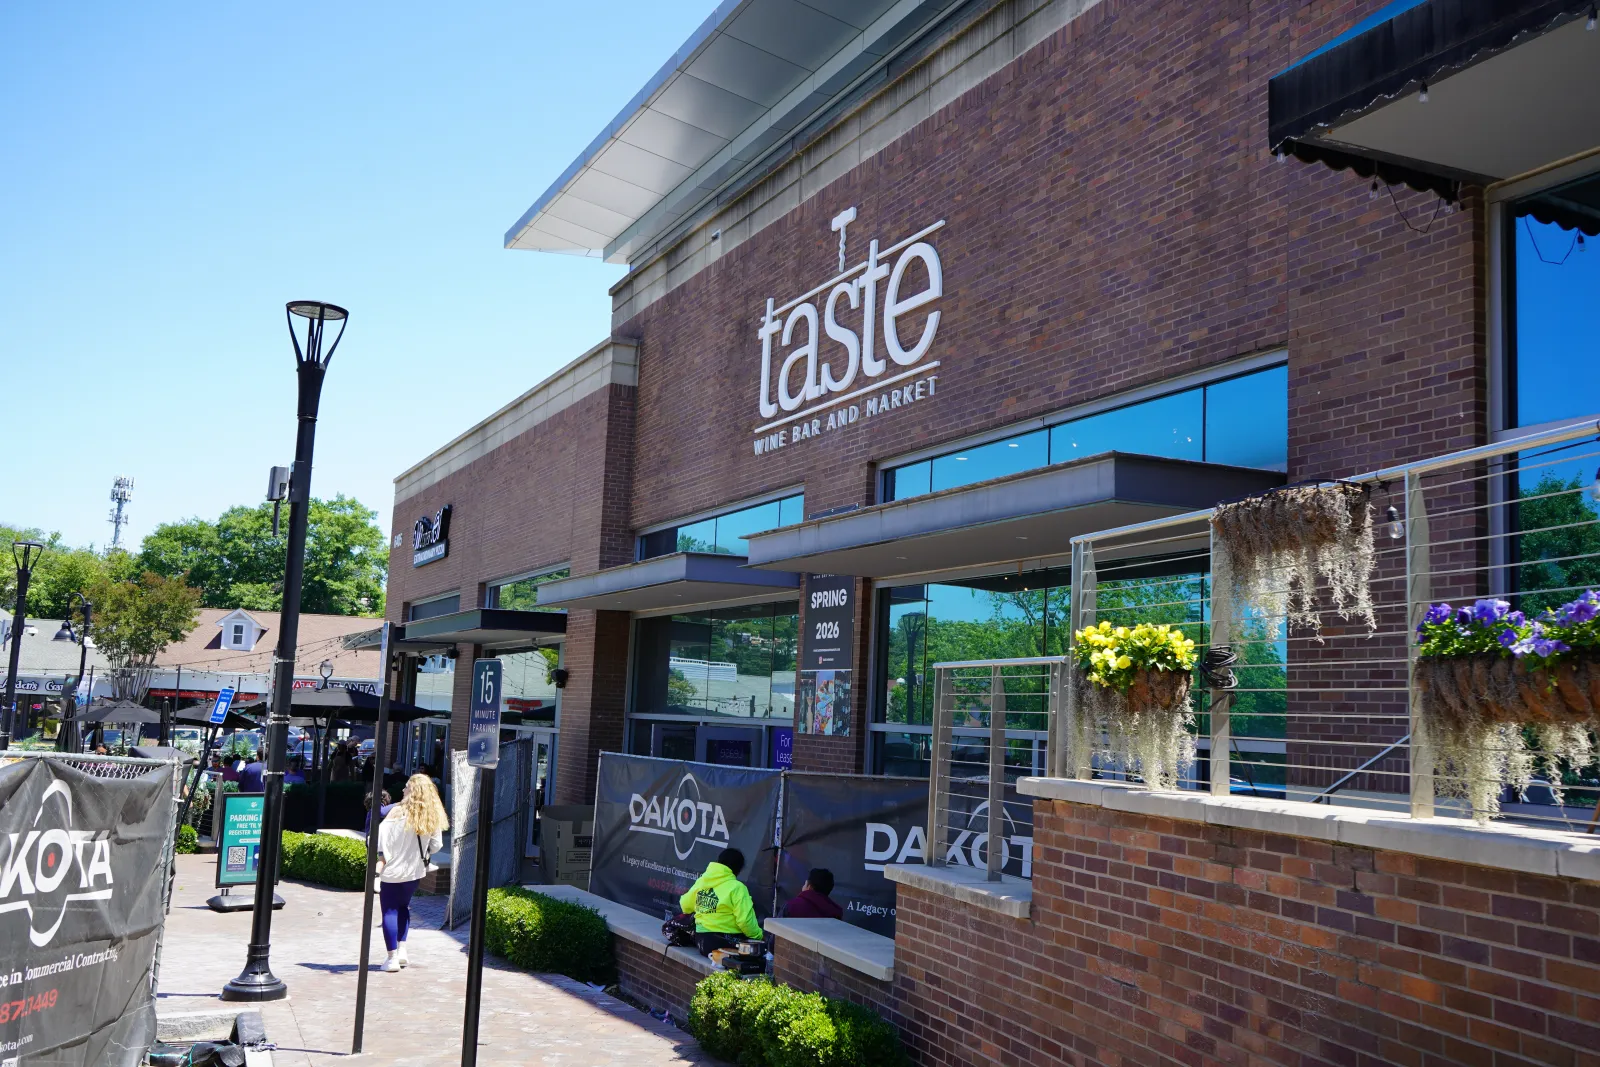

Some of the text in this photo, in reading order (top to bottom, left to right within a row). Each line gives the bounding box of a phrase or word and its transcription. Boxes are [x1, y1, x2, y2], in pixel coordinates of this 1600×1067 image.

[758, 239, 943, 418] taste
[753, 375, 939, 456] WINE BAR AND MARKET
[811, 588, 848, 609] SPRING
[815, 621, 840, 640] 2026
[321, 681, 377, 695] TANTA
[480, 671, 494, 705] 15
[474, 710, 496, 720] MINUTE
[472, 723, 496, 734] PARKING
[780, 734, 791, 748] For
[776, 749, 793, 764] Lease
[229, 814, 259, 822] PARKING
[629, 793, 729, 840] DAKOTA
[864, 823, 1033, 878] DAKOT
[626, 855, 641, 868] Legacy
[640, 859, 646, 868] of
[645, 860, 666, 873] Excellence
[666, 865, 672, 874] in
[672, 867, 699, 881] Commercial
[847, 901, 897, 918] A Legacy o
[10, 968, 23, 986] in
[25, 954, 75, 981] ommercial
